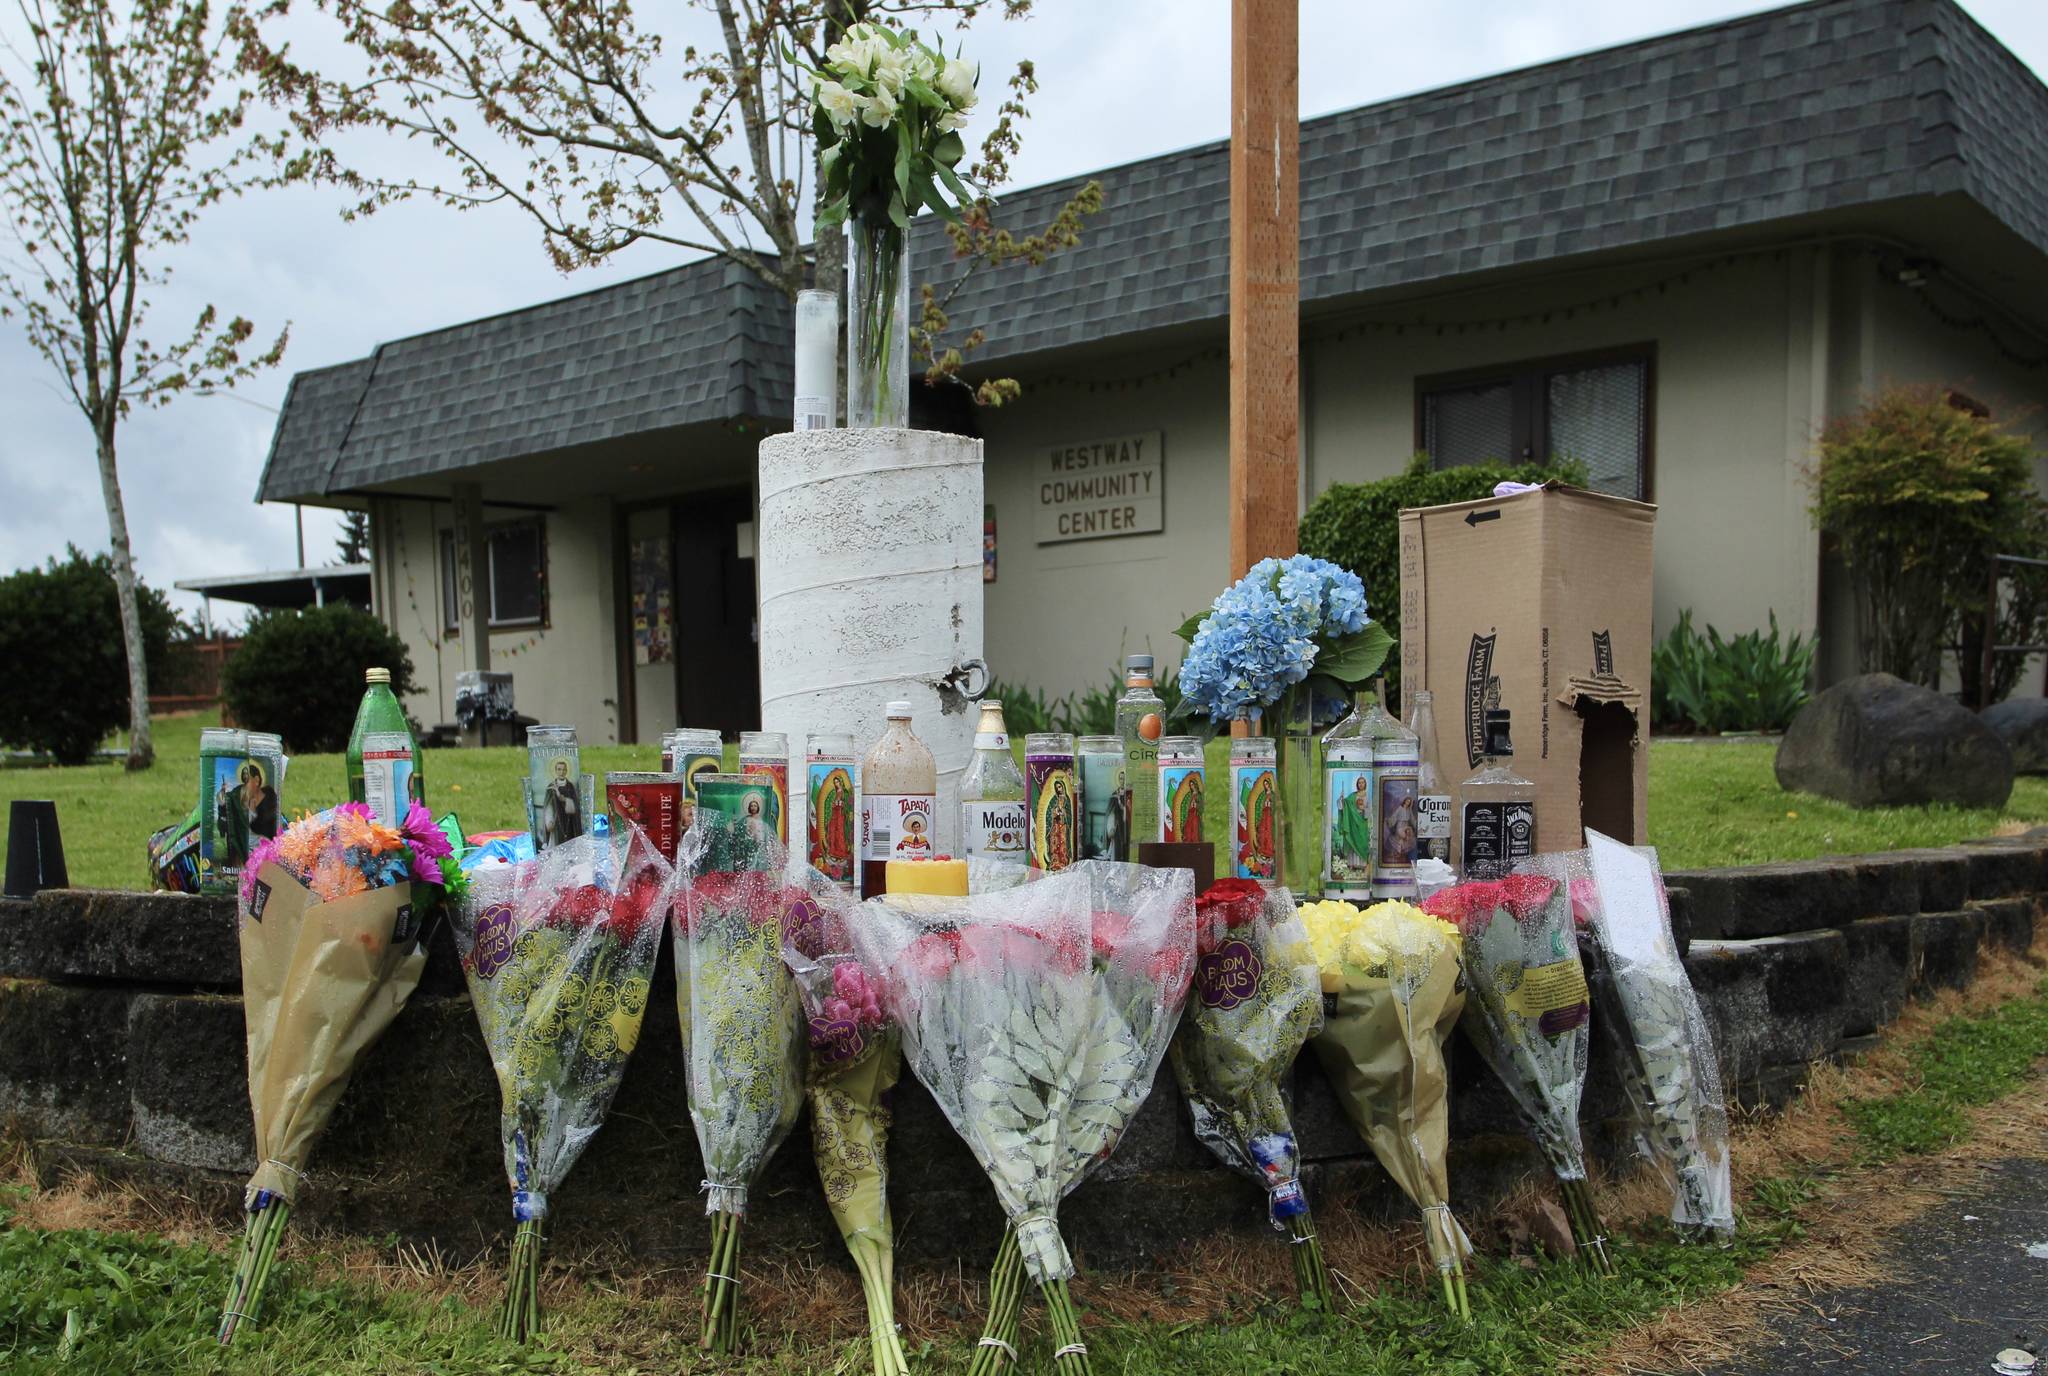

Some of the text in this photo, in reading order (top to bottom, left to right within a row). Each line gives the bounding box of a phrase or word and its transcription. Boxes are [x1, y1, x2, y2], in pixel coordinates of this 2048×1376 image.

[1051, 439, 1144, 472] WESTWAY
[1041, 470, 1153, 505] COMMUNITY
[1058, 506, 1136, 535] CENTER
[1472, 648, 1486, 754] PEPPERIDGE FARM
[661, 795, 672, 850] DE TU FE
[983, 811, 1026, 829] Modelo
[480, 921, 506, 946] BLOOM
[481, 936, 505, 963] HAUS
[1209, 972, 1248, 992] HAUS
